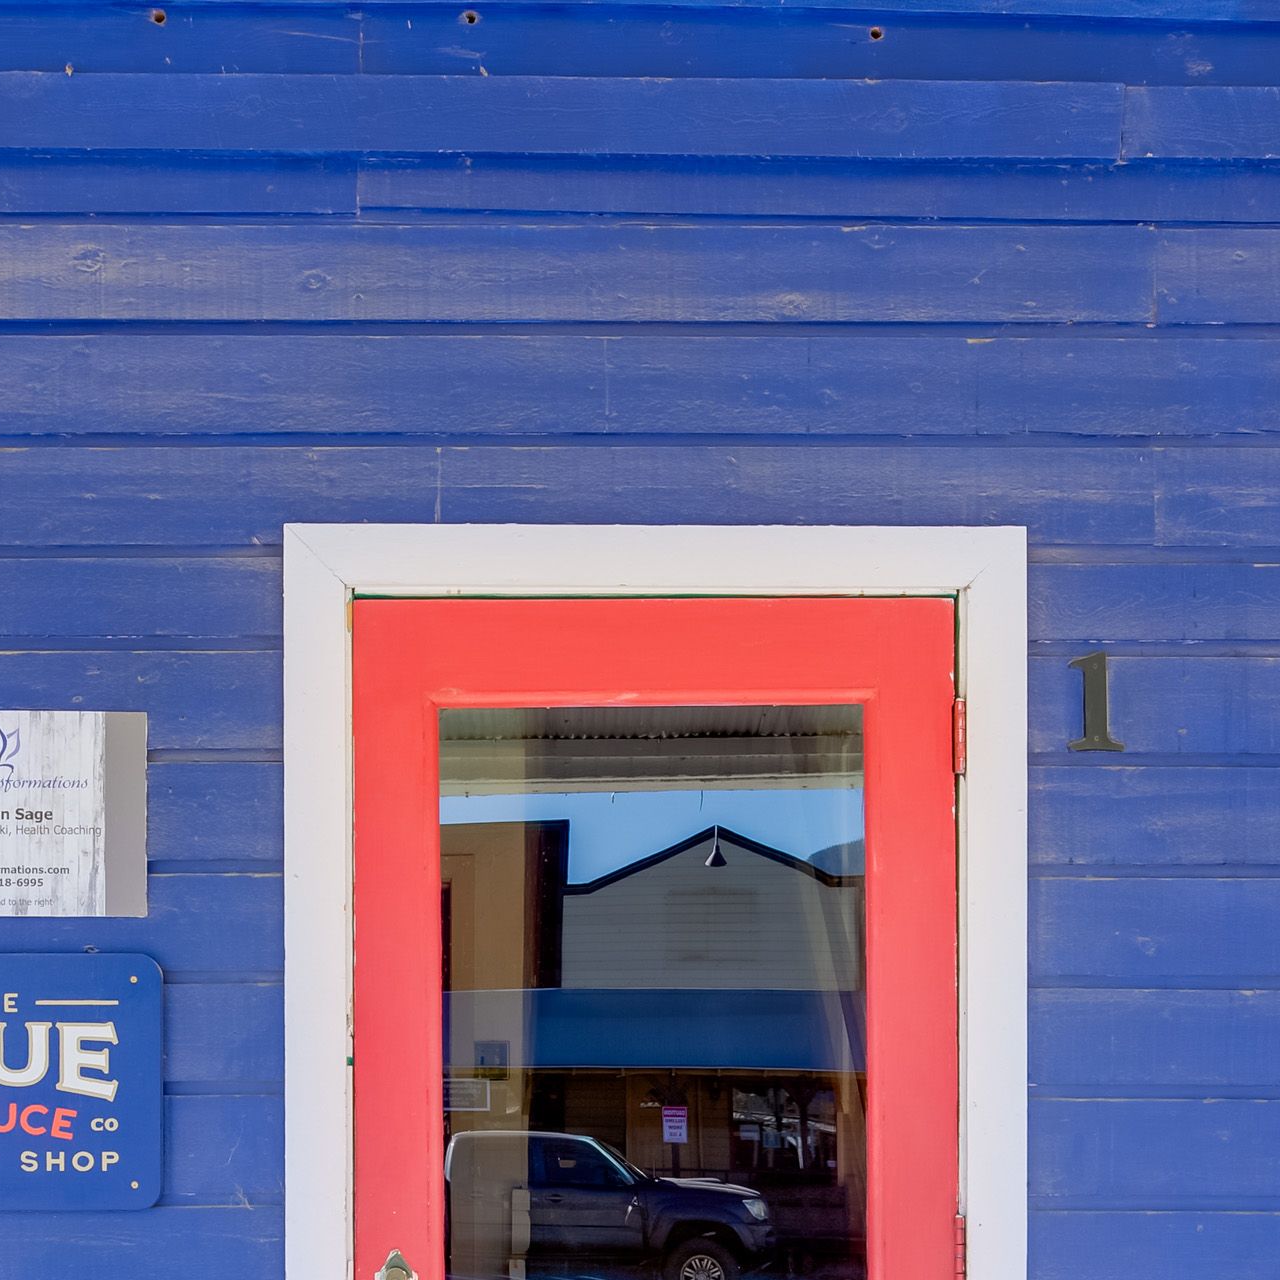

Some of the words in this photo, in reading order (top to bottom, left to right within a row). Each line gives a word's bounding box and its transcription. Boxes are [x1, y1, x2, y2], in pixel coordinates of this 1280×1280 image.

[1066, 651, 1125, 752] 1
[15, 808, 53, 824] Sage
[16, 825, 50, 836] Health
[53, 825, 102, 838] Coaching
[19, 898, 32, 906] the
[34, 898, 53, 908] right
[90, 1118, 119, 1131] CO
[20, 1151, 119, 1172] SHOP
